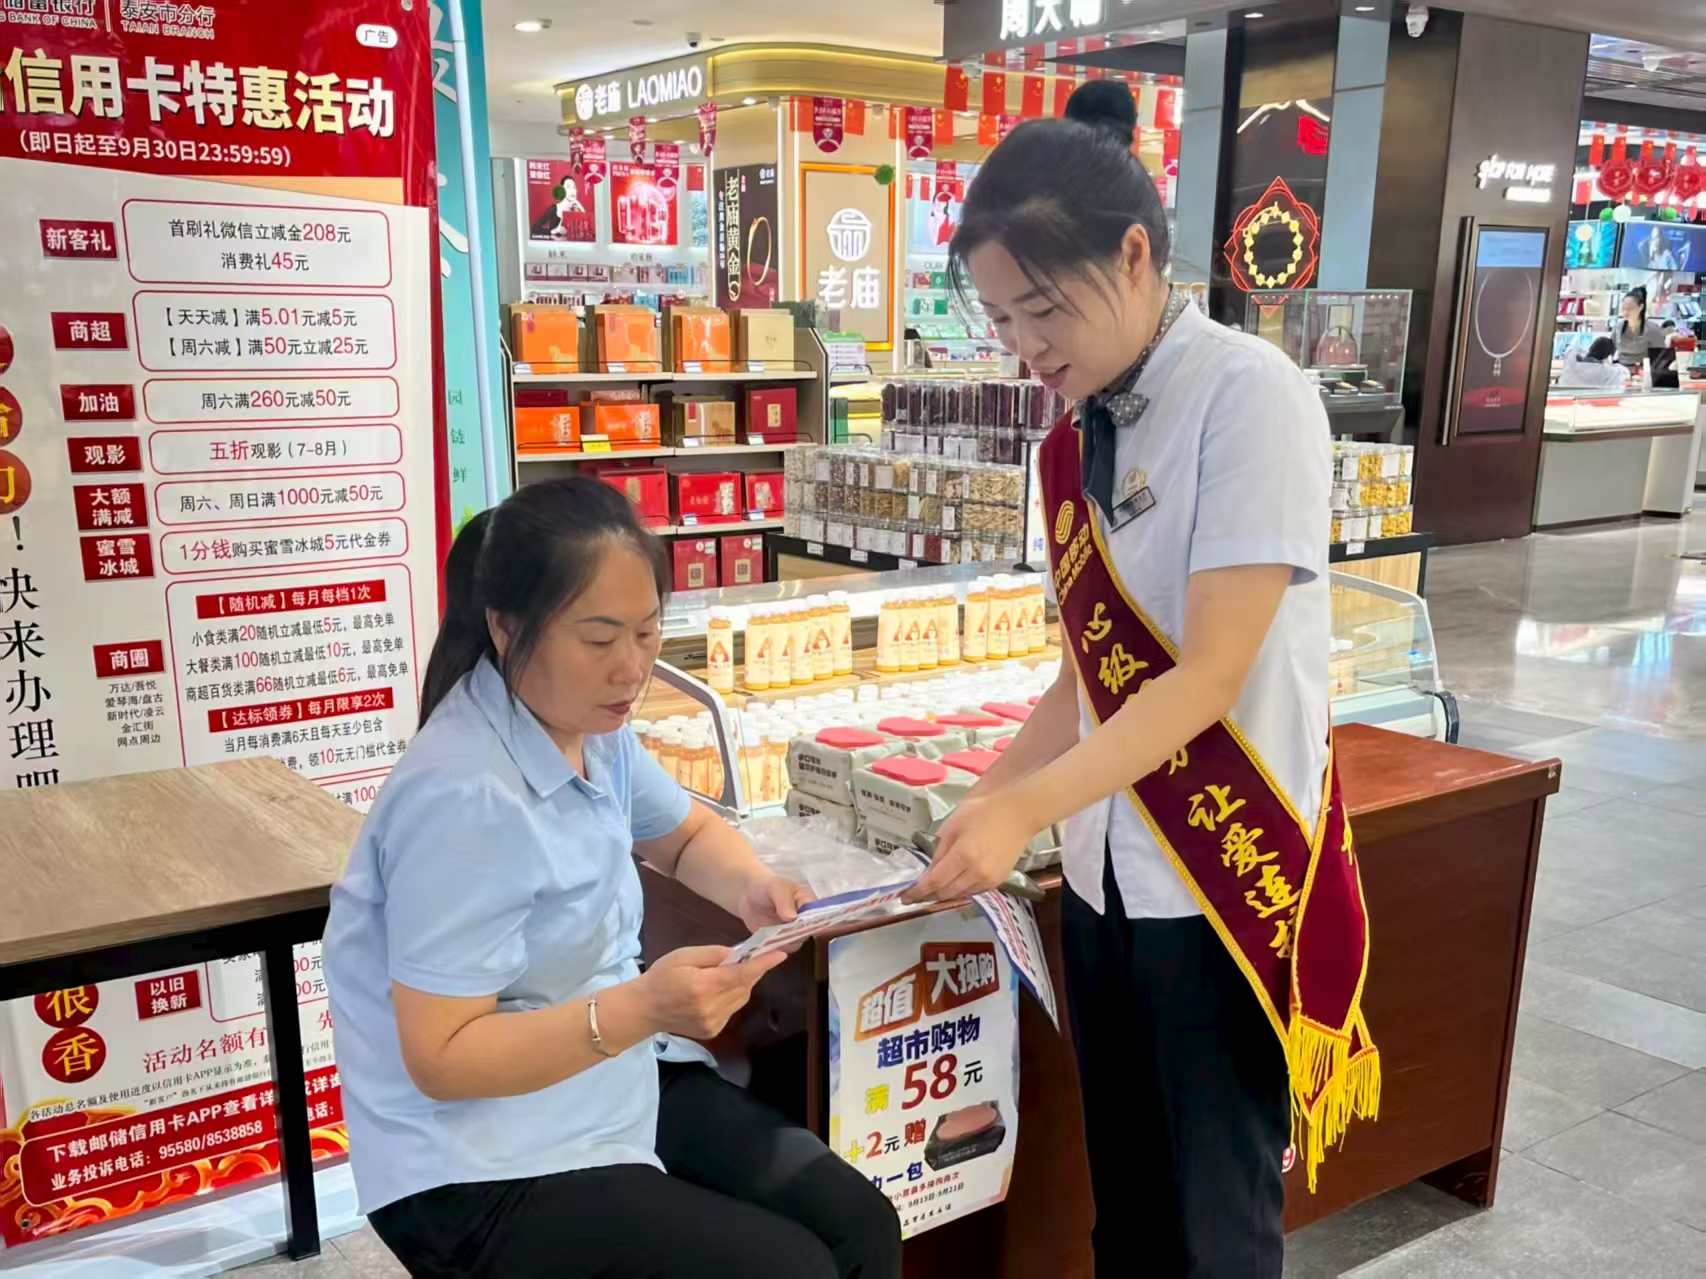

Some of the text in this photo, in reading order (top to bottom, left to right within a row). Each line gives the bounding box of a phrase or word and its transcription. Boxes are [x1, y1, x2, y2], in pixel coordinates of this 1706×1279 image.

[61, 16, 97, 29] CHINA
[119, 1, 215, 26] 泰安市分行
[121, 20, 215, 40] TAIAN BRANCH
[363, 29, 390, 44] 广告
[0, 47, 395, 138] 信用卡特惠活动
[627, 64, 703, 109] LAOMIAO
[45, 226, 111, 253] 新客礼
[168, 219, 352, 244] 首刷礼微信立减金208元
[221, 251, 310, 272] 消费礼45元
[817, 264, 881, 309] 老庙
[165, 307, 359, 328] 【天天减】满5.01元减5元
[68, 320, 113, 343] 商超
[168, 336, 370, 357] 【周六减】满50元立减25元
[78, 393, 121, 415] 加油
[201, 388, 352, 411] 周六满260元减50元
[84, 444, 127, 466] 观影
[90, 488, 132, 507] 大额
[180, 484, 384, 513] 周六、周日满1000元减50元
[92, 507, 134, 527] 满减
[96, 537, 137, 557] 蜜雪
[180, 531, 392, 561] 1分钱购买蜜雪冰城5元代金券
[98, 556, 141, 577] 冰城
[218, 584, 372, 615] 【随机减】每月每档1次
[108, 680, 157, 694] 万达/吾悦
[220, 692, 386, 729] 【达标领券】每月限享2次
[117, 733, 161, 747] 网点周边
[223, 716, 384, 754] 当月每消费满6天且每天至少包含
[149, 976, 186, 996] 以旧
[926, 951, 996, 1005] 大换购
[151, 996, 187, 1014] 换新
[877, 1014, 981, 1069] 超市购物
